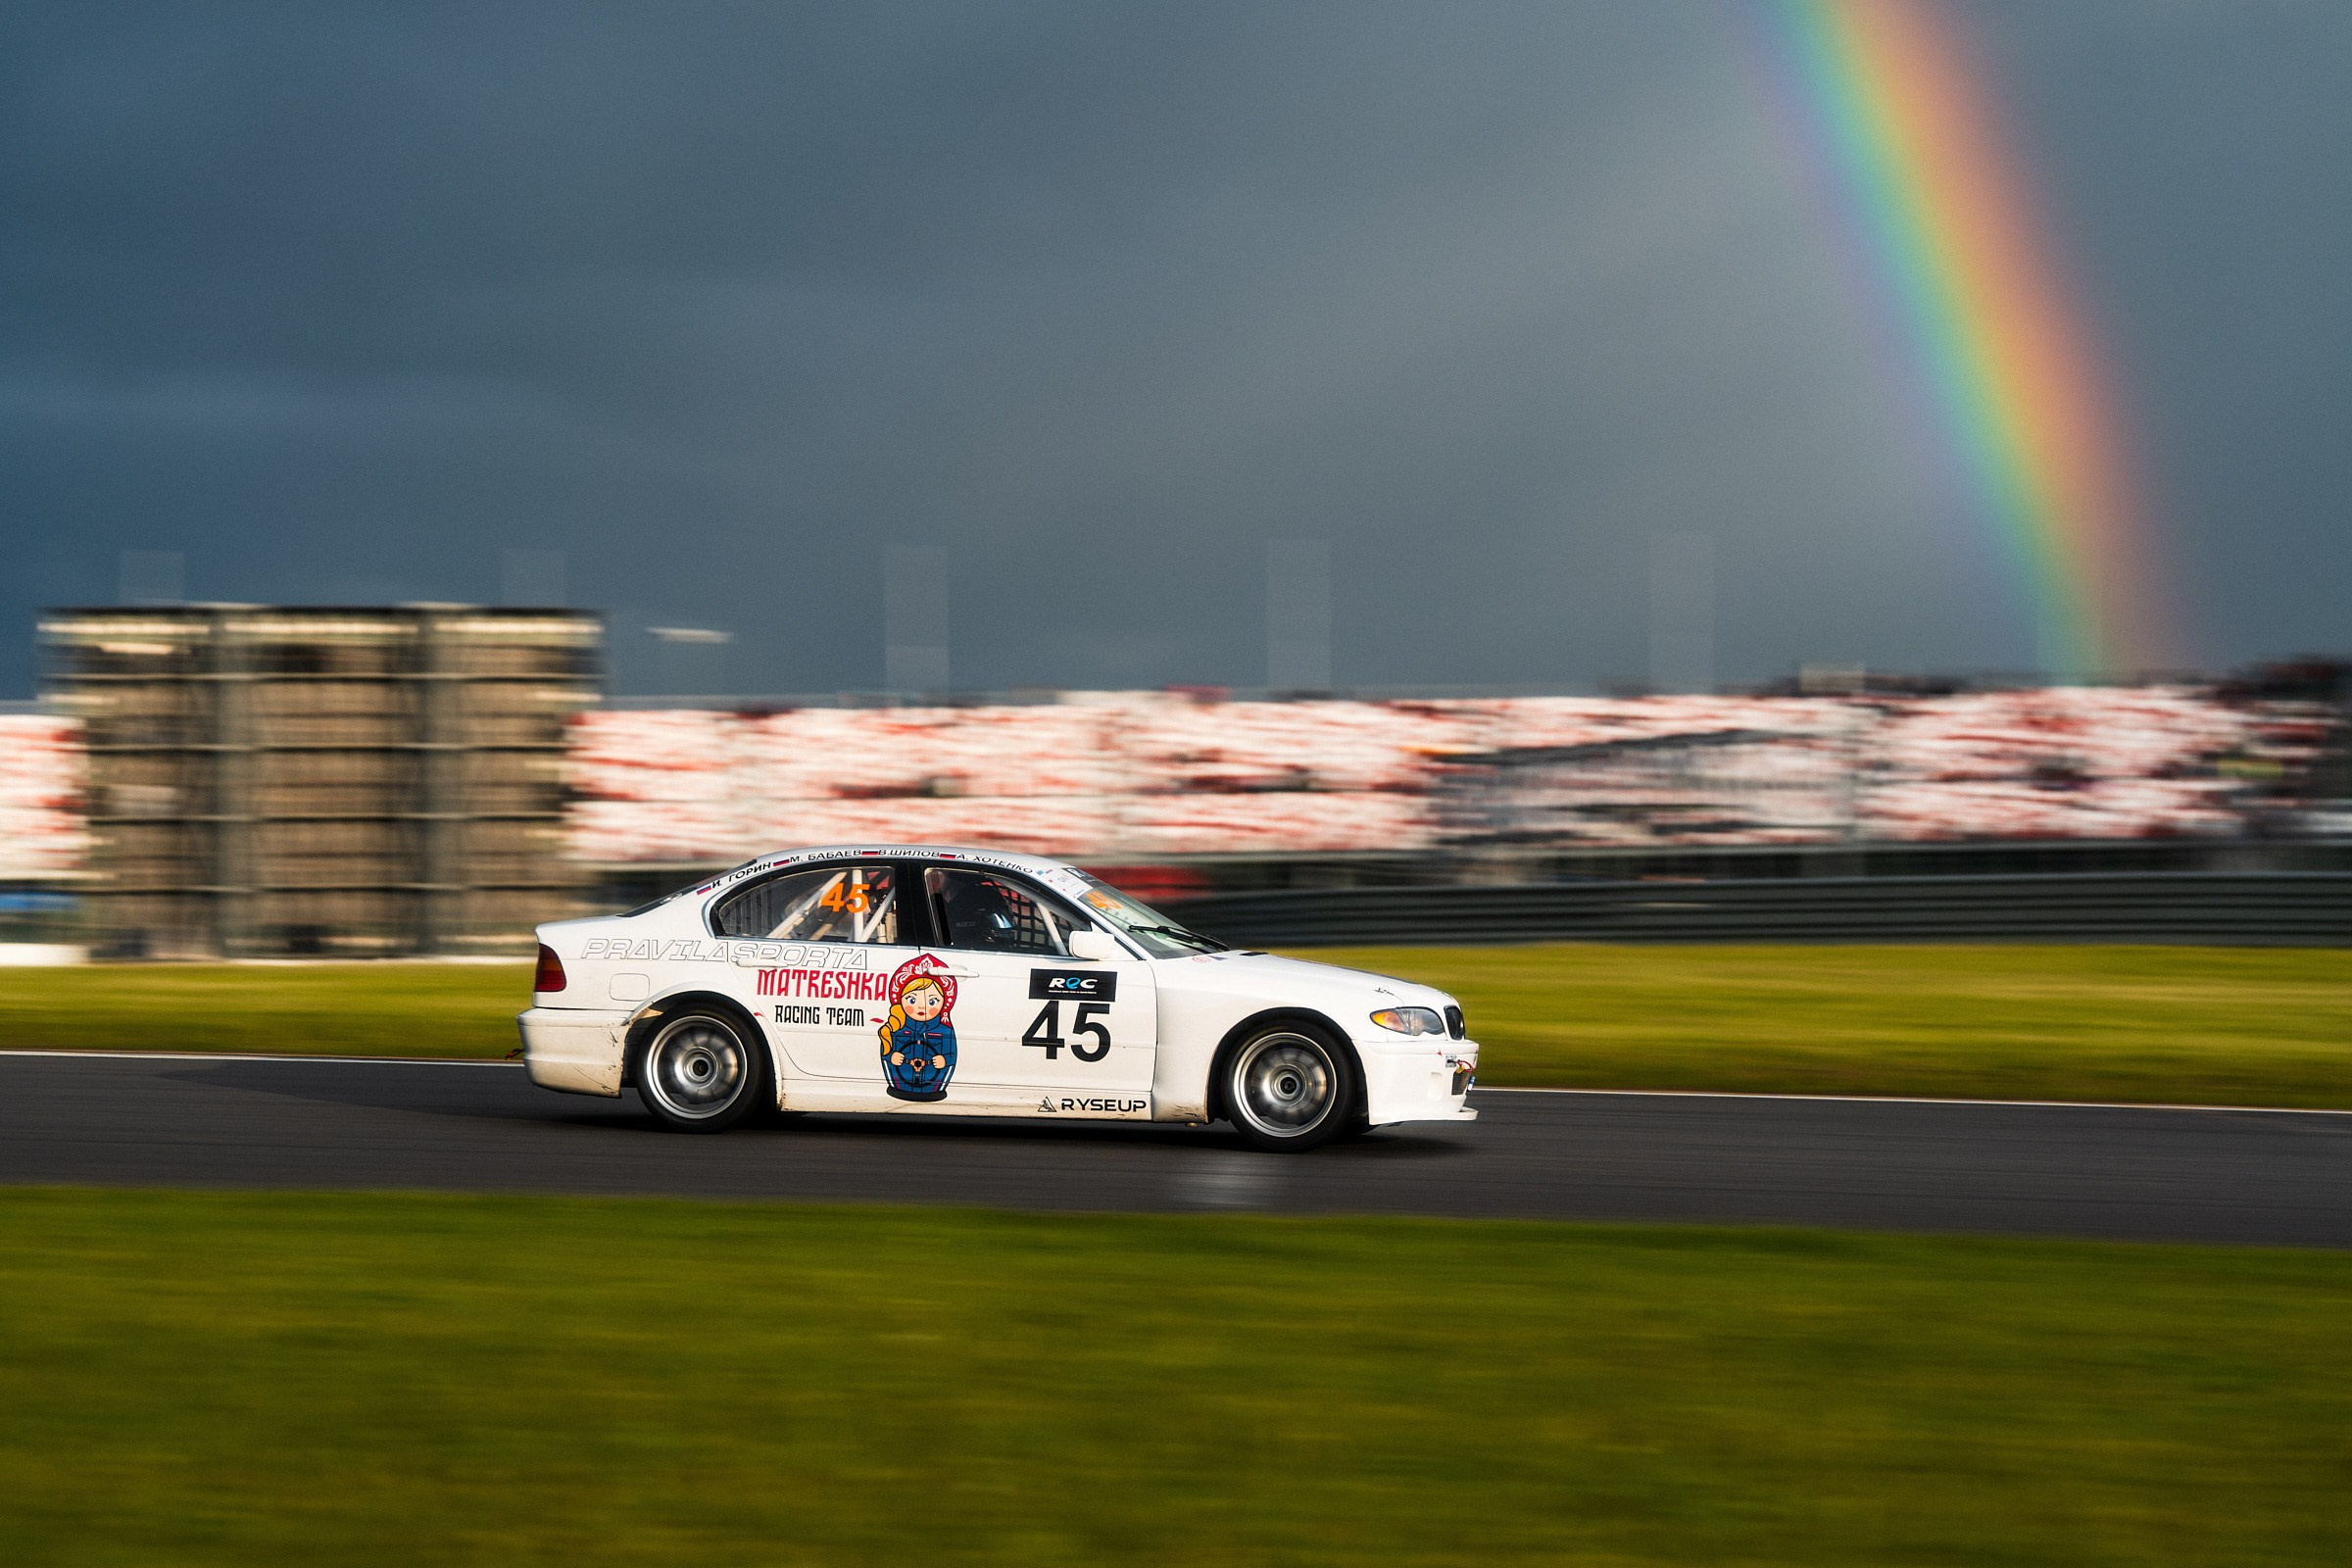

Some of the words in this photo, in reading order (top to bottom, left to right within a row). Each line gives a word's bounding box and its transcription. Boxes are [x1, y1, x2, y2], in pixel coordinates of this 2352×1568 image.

[728, 861, 771, 883] ГОРИН
[808, 849, 861, 860] БАБАЕВ
[973, 855, 1033, 874] ХОТЕНКО
[820, 882, 870, 912] 45
[757, 968, 889, 1002] MATRESHKA
[774, 1004, 820, 1026] RACING
[826, 1006, 864, 1027] TEAM
[1021, 1000, 1111, 1062] 45
[1061, 1098, 1147, 1112] RYSEUP
